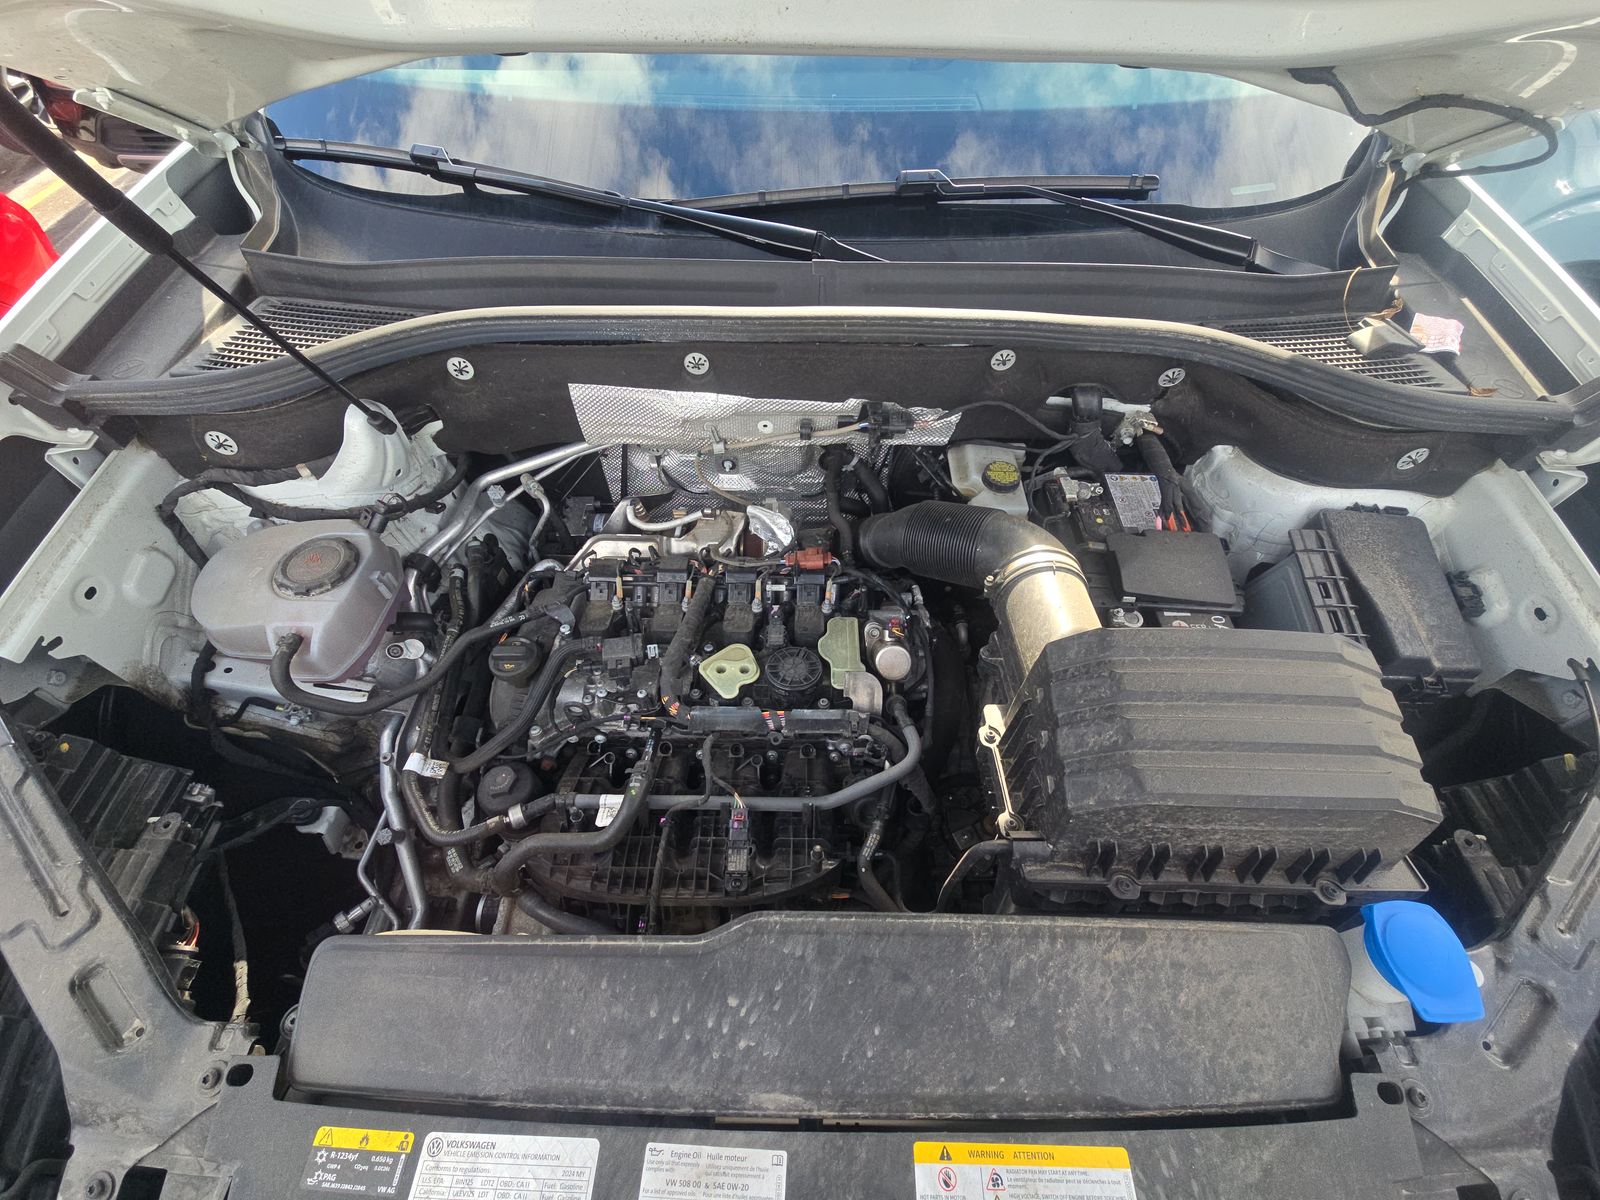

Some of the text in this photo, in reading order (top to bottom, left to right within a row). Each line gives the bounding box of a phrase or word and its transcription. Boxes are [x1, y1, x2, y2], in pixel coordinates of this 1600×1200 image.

[446, 1140, 497, 1150] VOLKSWAGEN
[330, 1152, 359, 1162] R-1234yf
[385, 1156, 394, 1165] kg
[443, 1150, 561, 1161] VEHICLE EMISSION CONTROL INFORMATION
[670, 1150, 748, 1162] Engine Oil Huile moteur
[967, 1150, 1055, 1161] WARNING ATTENTION
[424, 1164, 451, 1172] Conforms
[480, 1179, 495, 1187] LDT2
[559, 1182, 584, 1190] Gasoline
[665, 1178, 750, 1192] VW 508 00 & SAE 0W-20
[377, 1185, 396, 1194] VW AG
